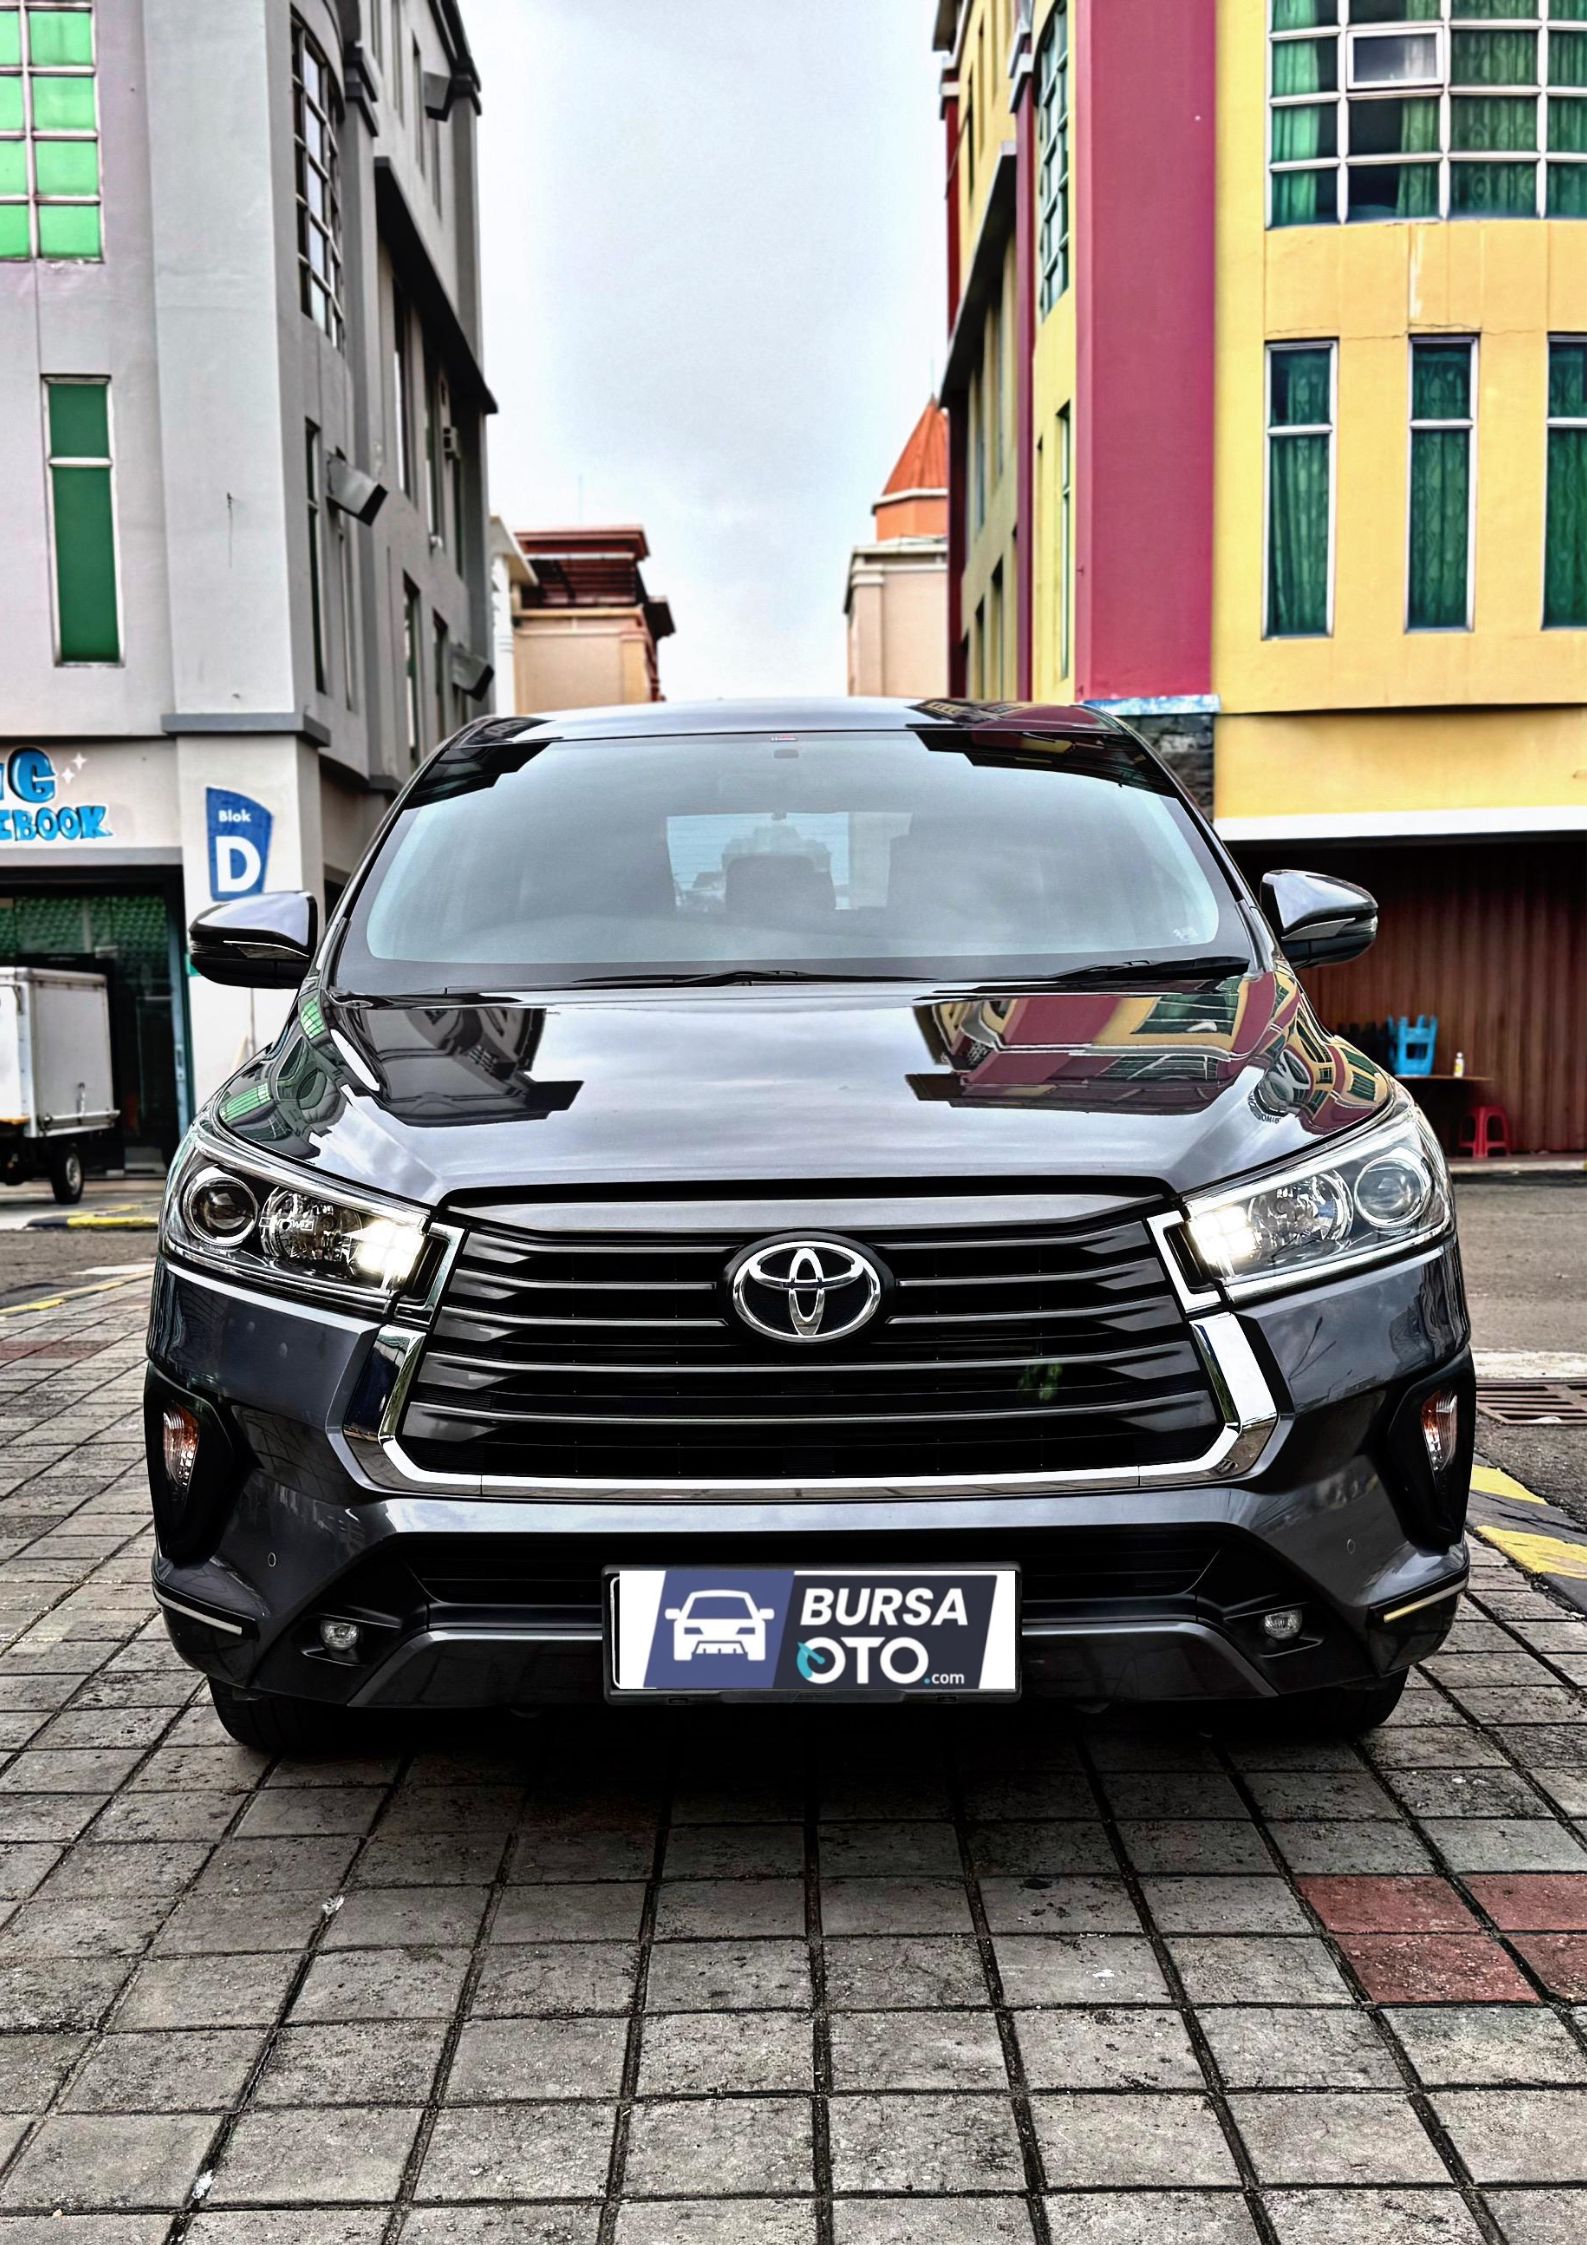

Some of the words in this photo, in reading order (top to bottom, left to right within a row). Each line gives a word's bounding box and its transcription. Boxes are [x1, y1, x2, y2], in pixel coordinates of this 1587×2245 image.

[0, 747, 56, 804] G
[218, 808, 252, 823] Blok
[216, 835, 261, 892] D
